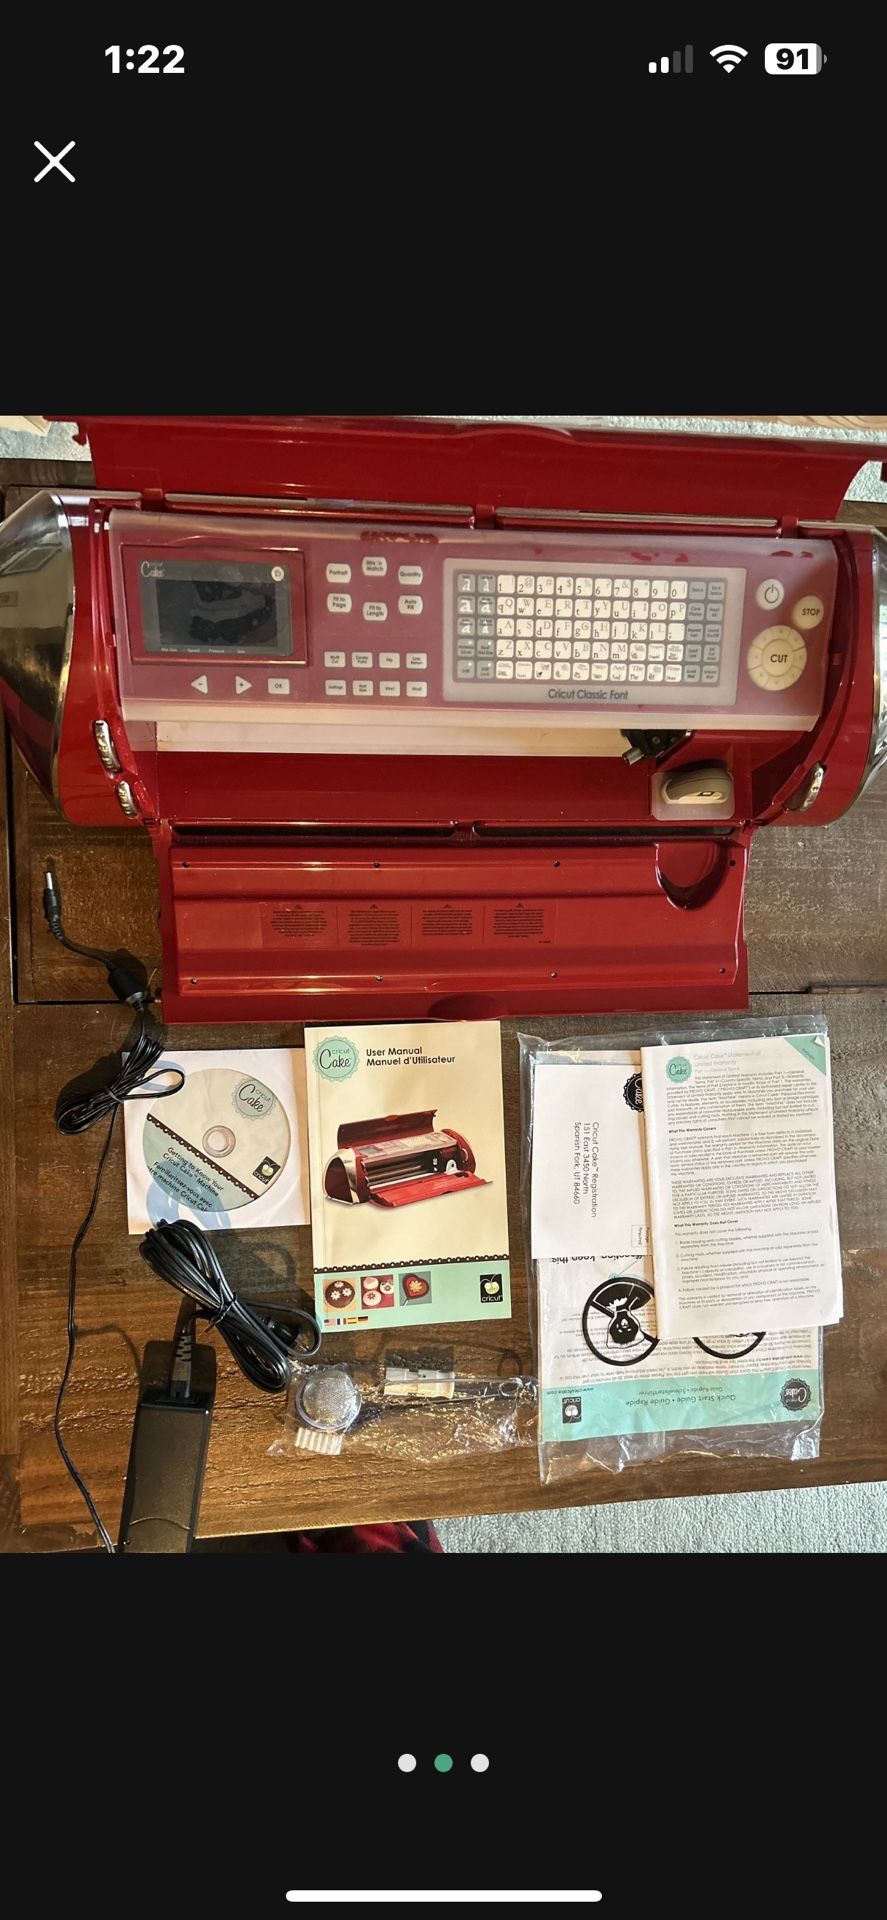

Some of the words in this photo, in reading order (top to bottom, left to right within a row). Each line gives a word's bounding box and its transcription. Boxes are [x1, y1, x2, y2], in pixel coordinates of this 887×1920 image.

[519, 584, 523, 592] 2
[538, 585, 543, 593] 3
[548, 689, 575, 699] Cricut
[577, 690, 607, 699] Classic
[610, 690, 628, 699] Font
[388, 1046, 422, 1055] Manual
[366, 1057, 400, 1066] Manuel
[404, 1056, 455, 1064] d'Utilisateur
[239, 1084, 263, 1112] Cake
[168, 1147, 188, 1165] Getting
[195, 1168, 211, 1181] Know
[212, 1180, 223, 1190] Your
[163, 1153, 179, 1167] Cricut
[196, 1178, 218, 1196] Machine
[574, 1172, 580, 1180] UT
[158, 1175, 179, 1192] machine
[181, 1191, 197, 1205] Cricut
[590, 1173, 598, 1218] Registration
[200, 1197, 212, 1207] avec
[717, 1394, 736, 1402] Quick
